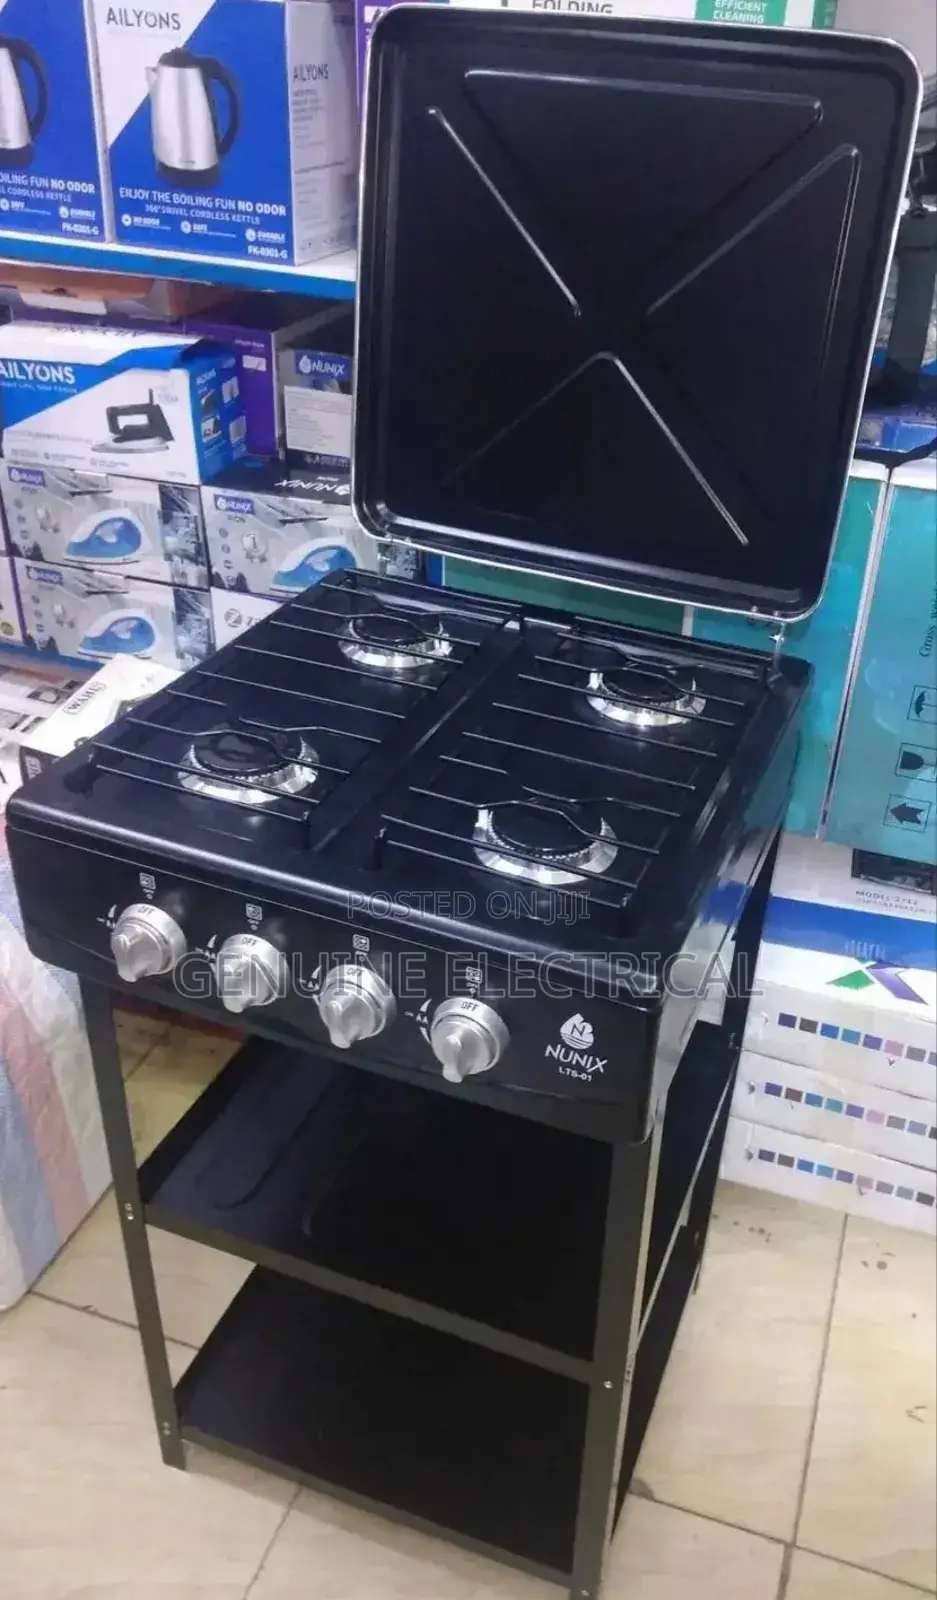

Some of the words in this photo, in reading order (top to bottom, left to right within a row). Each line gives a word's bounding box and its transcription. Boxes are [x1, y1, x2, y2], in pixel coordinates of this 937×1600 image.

[715, 0, 768, 12] EFFICIENT
[106, 6, 181, 31] AILYONS
[713, 10, 765, 24] CLEANING
[293, 64, 329, 82] AILYONS
[30, 176, 49, 188] FUN
[50, 178, 65, 190] NO
[66, 181, 96, 194] ODOR
[119, 187, 150, 200] ENJOY
[151, 191, 172, 203] THE
[172, 193, 213, 208] BOILING
[215, 197, 236, 210] FUN
[237, 200, 253, 212] NO
[255, 202, 286, 216] ODOR
[189, 209, 230, 222] CORDLESS
[231, 214, 260, 226] KETTLE
[247, 244, 288, 259] FK-0301-G
[311, 360, 346, 377] NUNIX
[274, 478, 335, 492] NUNIX
[137, 905, 156, 915] OFF
[241, 936, 258, 947] OFF
[347, 966, 365, 976] OFF
[460, 1001, 479, 1012] OFF
[545, 1044, 608, 1074] NUNIX
[558, 1066, 593, 1082] LTS-01
